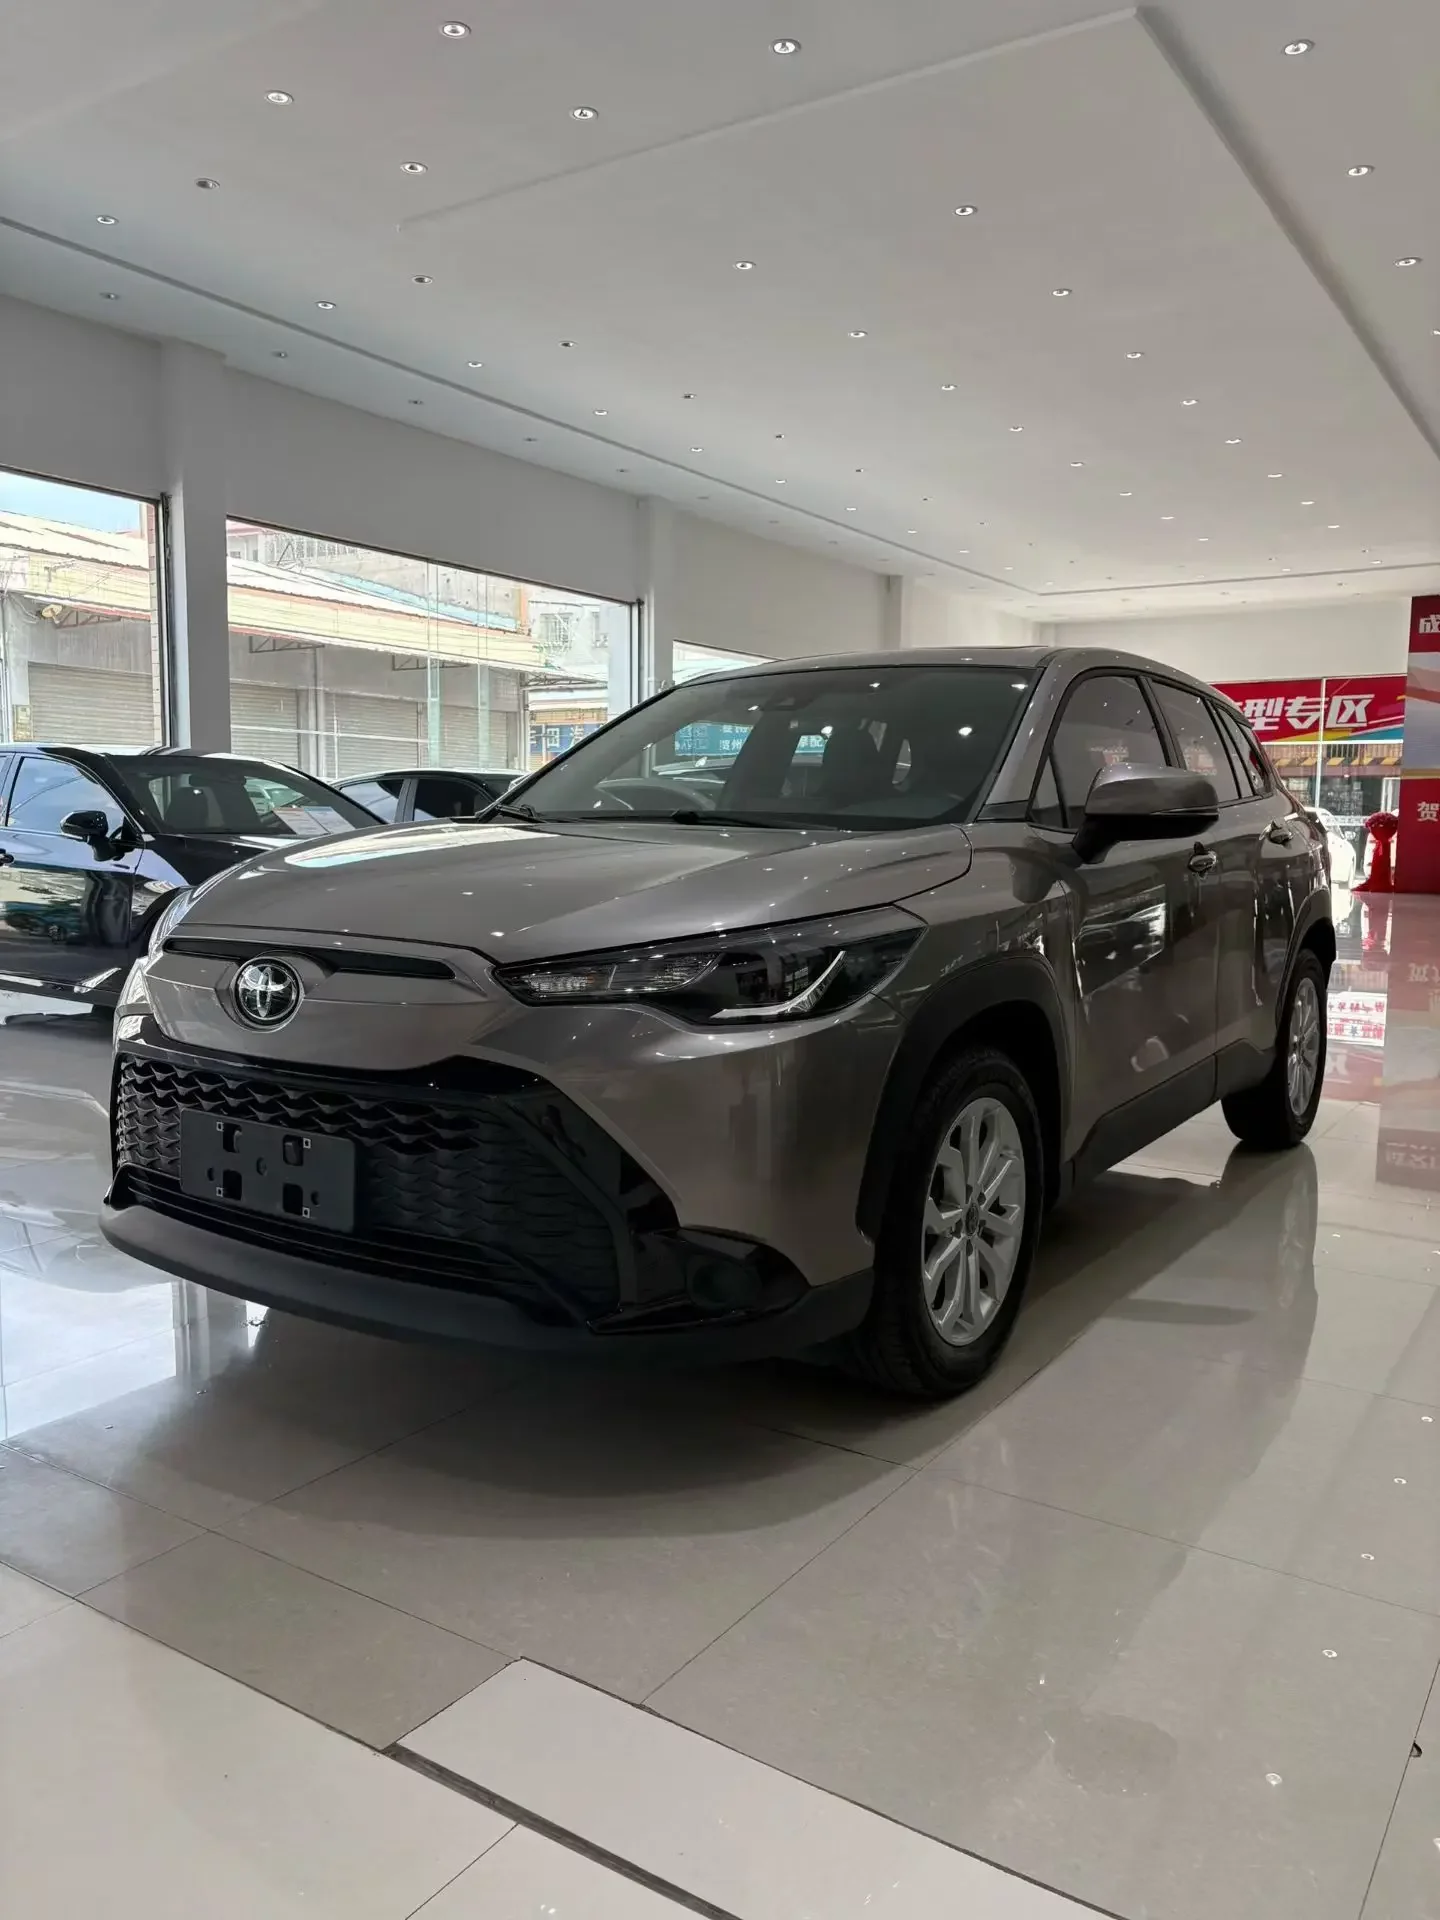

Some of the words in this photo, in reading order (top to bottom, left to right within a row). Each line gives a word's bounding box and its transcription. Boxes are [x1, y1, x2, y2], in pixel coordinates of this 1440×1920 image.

[1234, 694, 1375, 731] 型专区
[1417, 801, 1439, 822] 贺
